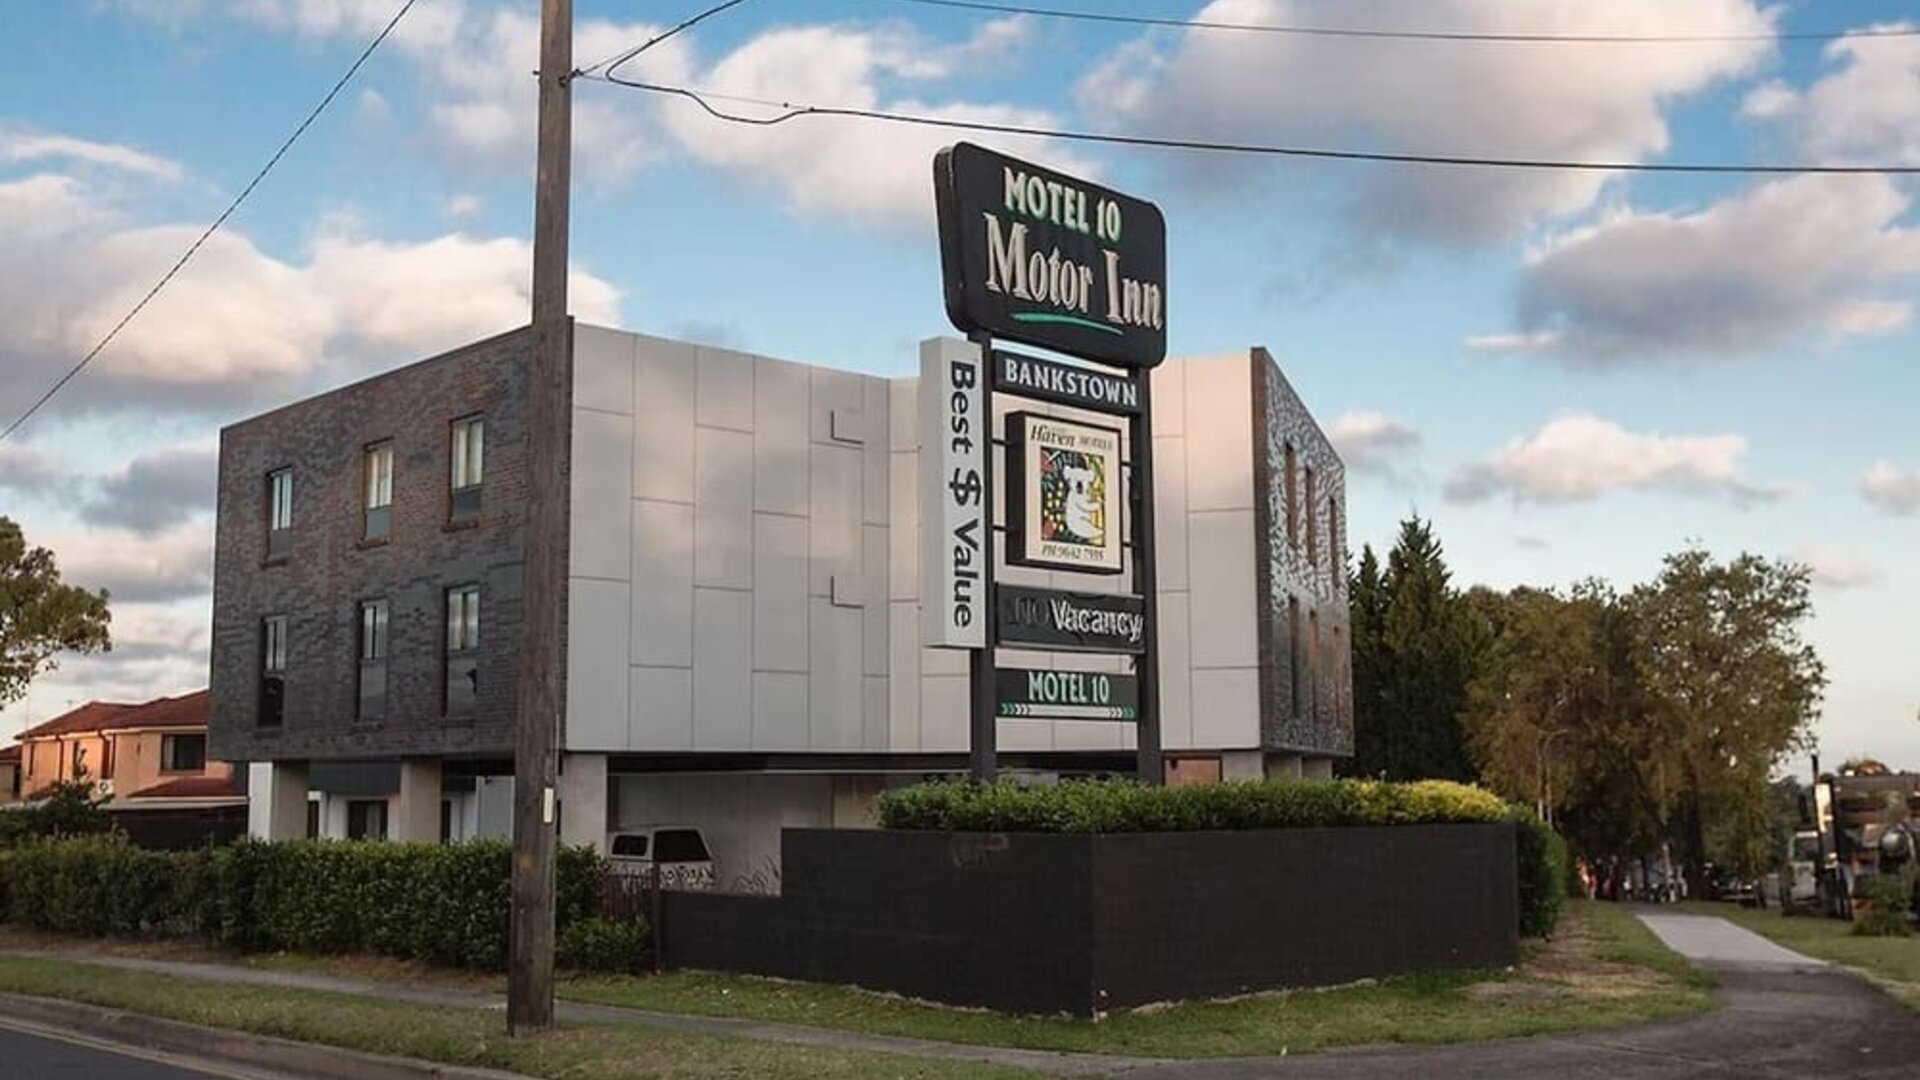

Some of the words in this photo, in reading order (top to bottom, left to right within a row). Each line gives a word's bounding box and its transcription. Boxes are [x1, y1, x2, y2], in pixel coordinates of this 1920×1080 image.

[1004, 167, 1090, 233] MOTEL
[1096, 199, 1122, 242] 10
[983, 212, 1093, 313] Motor
[1102, 249, 1162, 331] Inn
[951, 360, 976, 454] Best
[1004, 358, 1137, 407] BANKSTOWN
[1030, 423, 1076, 447] Haven
[949, 469, 982, 507] $
[953, 518, 979, 629] Value
[1050, 598, 1144, 643] Vacancy
[1028, 671, 1087, 703] MOTEL
[1091, 675, 1110, 704] 10
